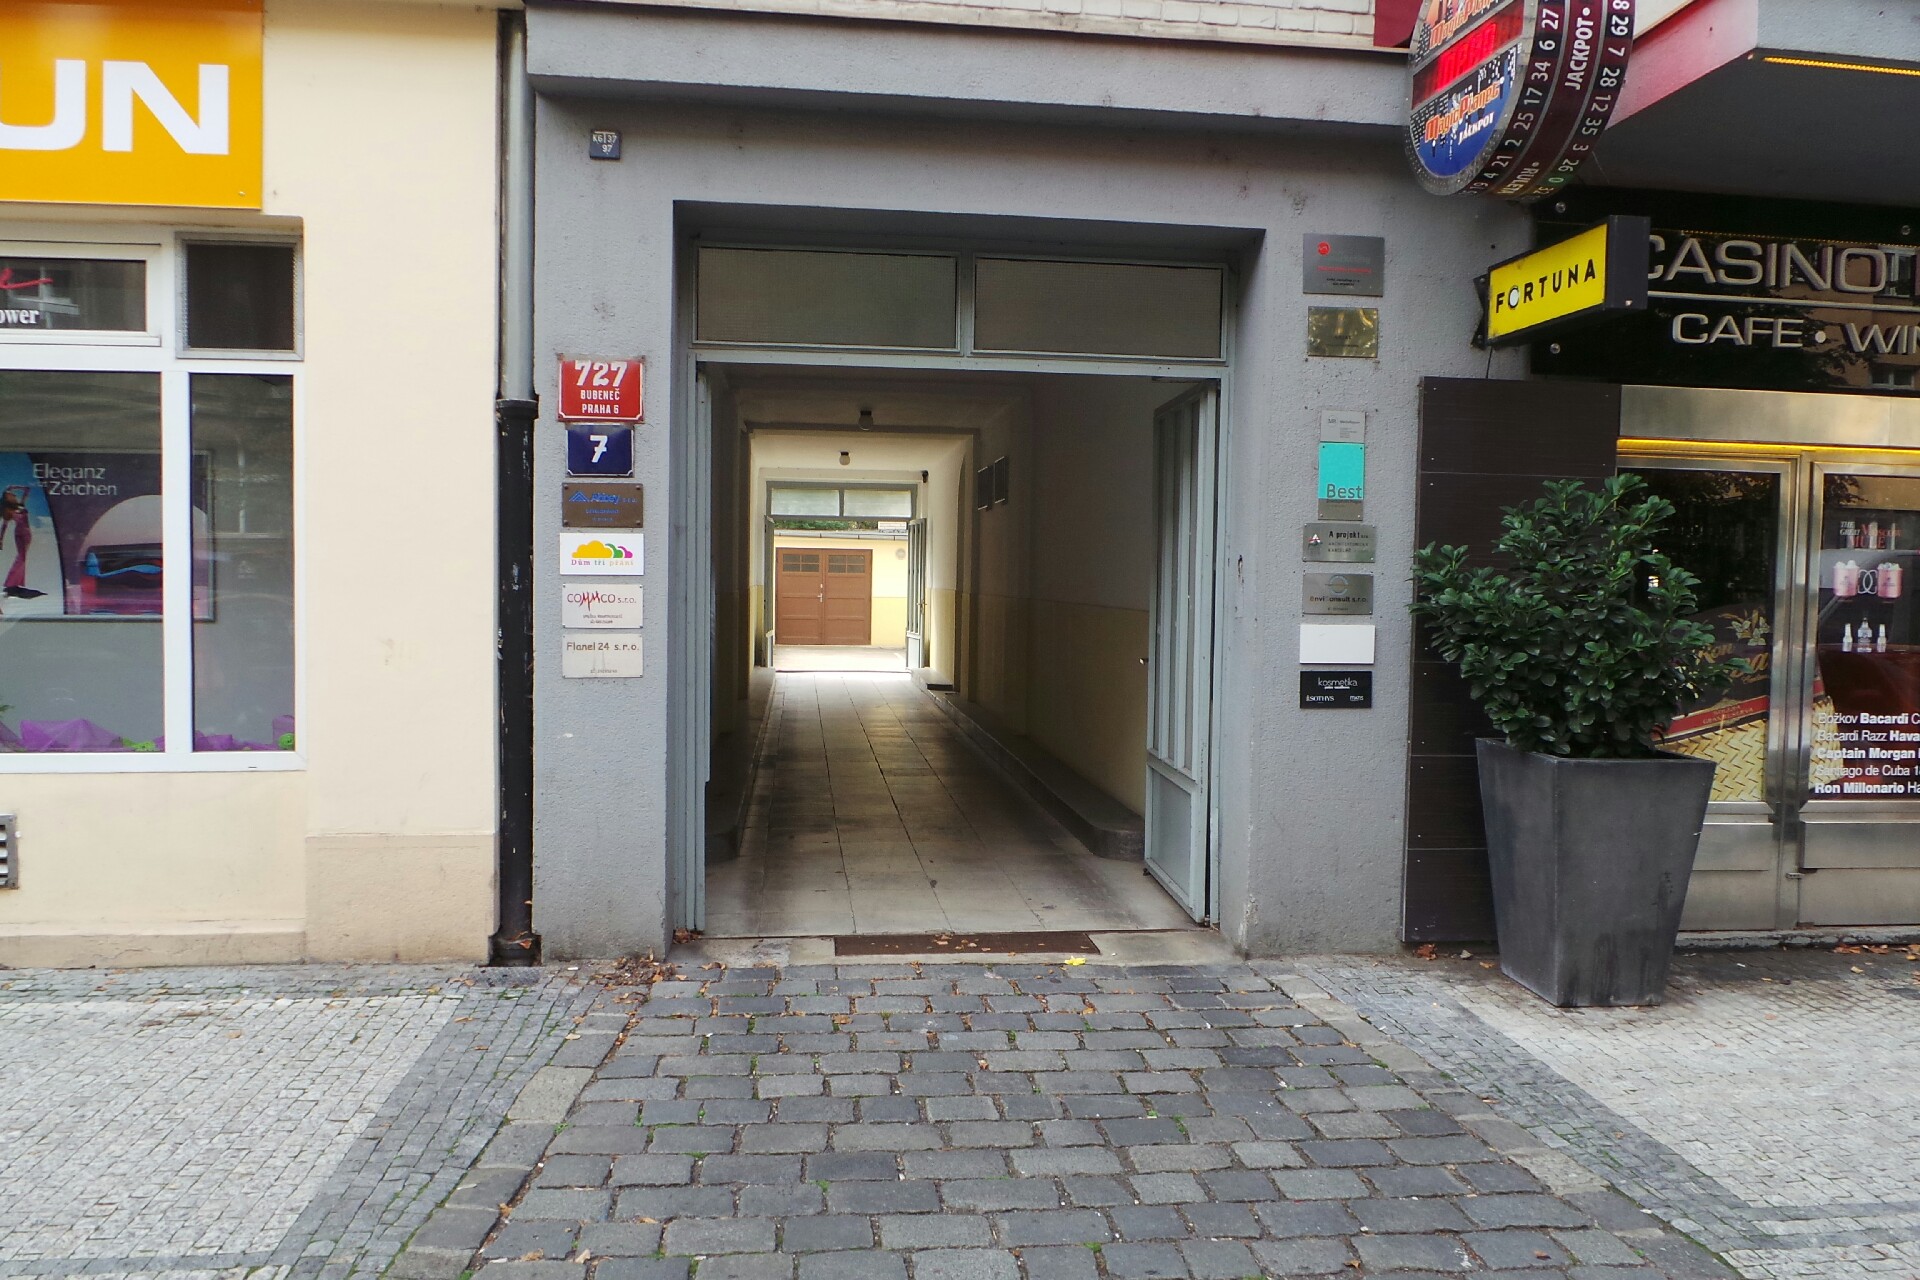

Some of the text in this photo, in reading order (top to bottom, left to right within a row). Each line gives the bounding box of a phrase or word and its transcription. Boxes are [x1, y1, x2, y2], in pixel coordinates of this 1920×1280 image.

[1541, 8, 1559, 30] 27
[1610, 14, 1629, 36] 29
[1538, 39, 1556, 51] 6
[1607, 47, 1625, 57] 7
[1564, 17, 1594, 91] JACKPOT
[1531, 61, 1551, 82] 34
[1600, 67, 1620, 87] 28
[1523, 87, 1543, 105] 17
[1594, 94, 1612, 112] 12
[0, 59, 229, 155] UN
[1514, 112, 1534, 131] 25
[1581, 117, 1602, 136] 35
[1505, 139, 1522, 148] 2
[1572, 142, 1589, 151] 3
[1491, 155, 1513, 168] 21
[1557, 158, 1579, 172] 26
[1496, 259, 1596, 314] FORTUNA
[1672, 313, 1804, 348] CAFE
[574, 360, 628, 387] 727
[580, 388, 620, 400] BUBENEČ
[582, 403, 619, 414] PRAHA 6
[589, 434, 609, 463] 7
[33, 462, 106, 483] Eleganz
[49, 481, 117, 496] Zeichen
[1326, 483, 1362, 499] Best
[1328, 530, 1334, 538] A
[1336, 531, 1360, 539] projekt
[566, 642, 596, 651] Flanel
[598, 642, 610, 651] 24
[1317, 677, 1358, 687] kosmetika
[1818, 712, 1858, 724] Božkov
[1860, 713, 1909, 724] Bacardi
[1817, 730, 1859, 741] Bacardi
[1861, 730, 1888, 741] Razz
[1816, 747, 1866, 761] Captain
[1868, 748, 1916, 761] Morgan
[1815, 765, 1863, 778] Santiago
[1865, 765, 1880, 775] de
[1882, 765, 1910, 776] Cuba
[1814, 783, 1841, 794] Ron
